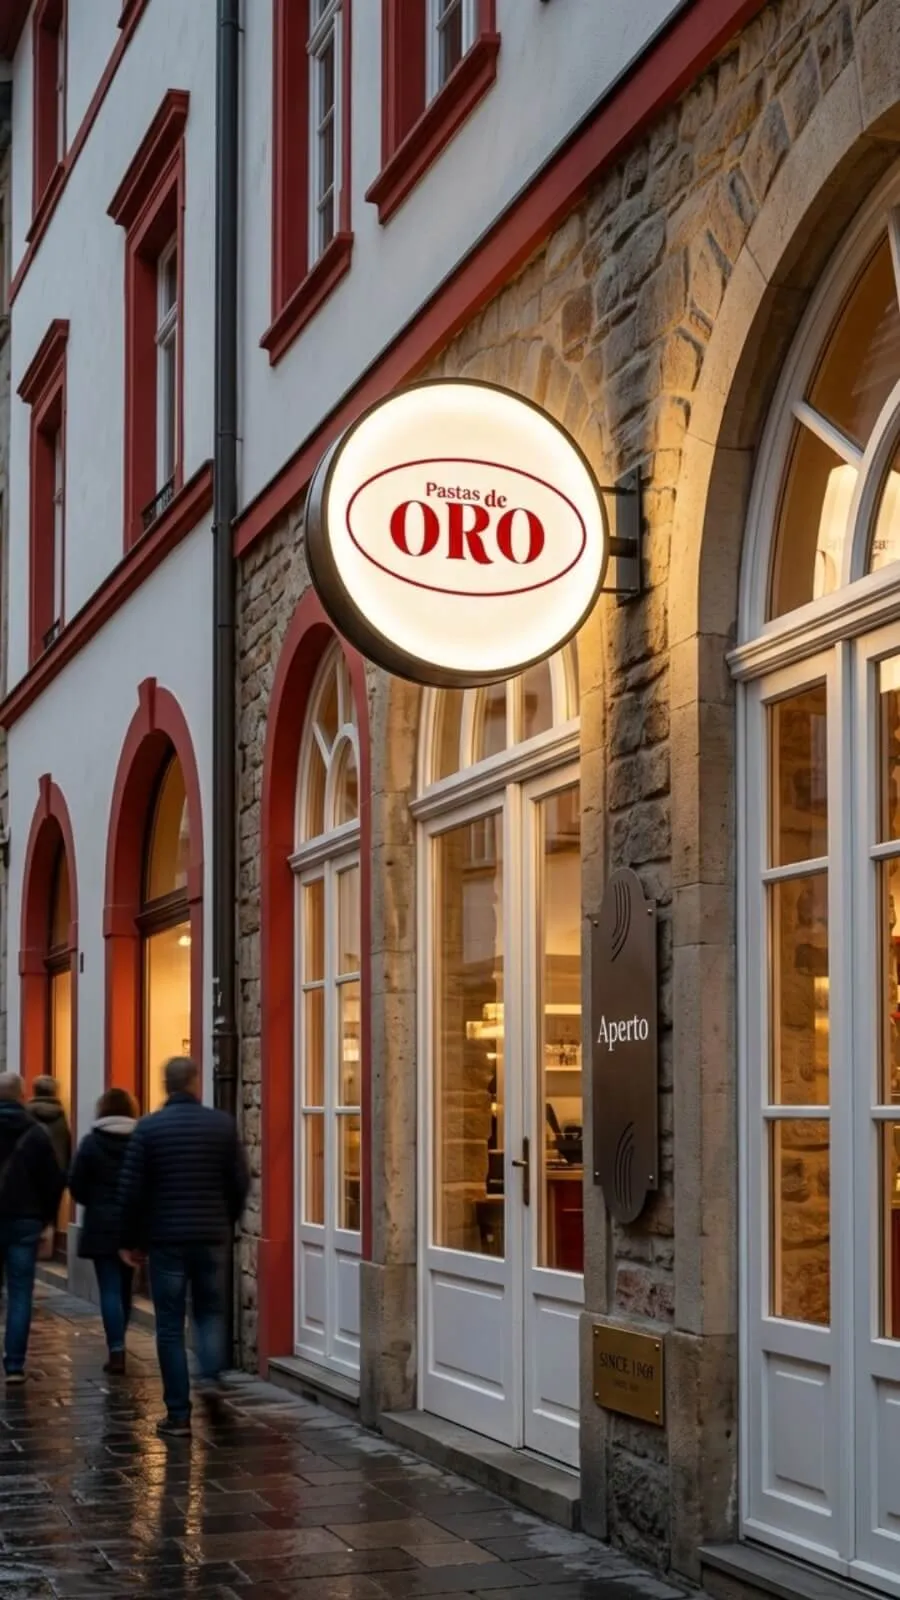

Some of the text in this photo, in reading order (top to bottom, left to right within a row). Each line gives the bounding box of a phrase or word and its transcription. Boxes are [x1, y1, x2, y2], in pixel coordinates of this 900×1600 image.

[426, 482, 507, 509] Pastas de
[389, 499, 546, 565] ORO
[597, 1015, 649, 1052] Aperto
[599, 1351, 630, 1374] SINCE
